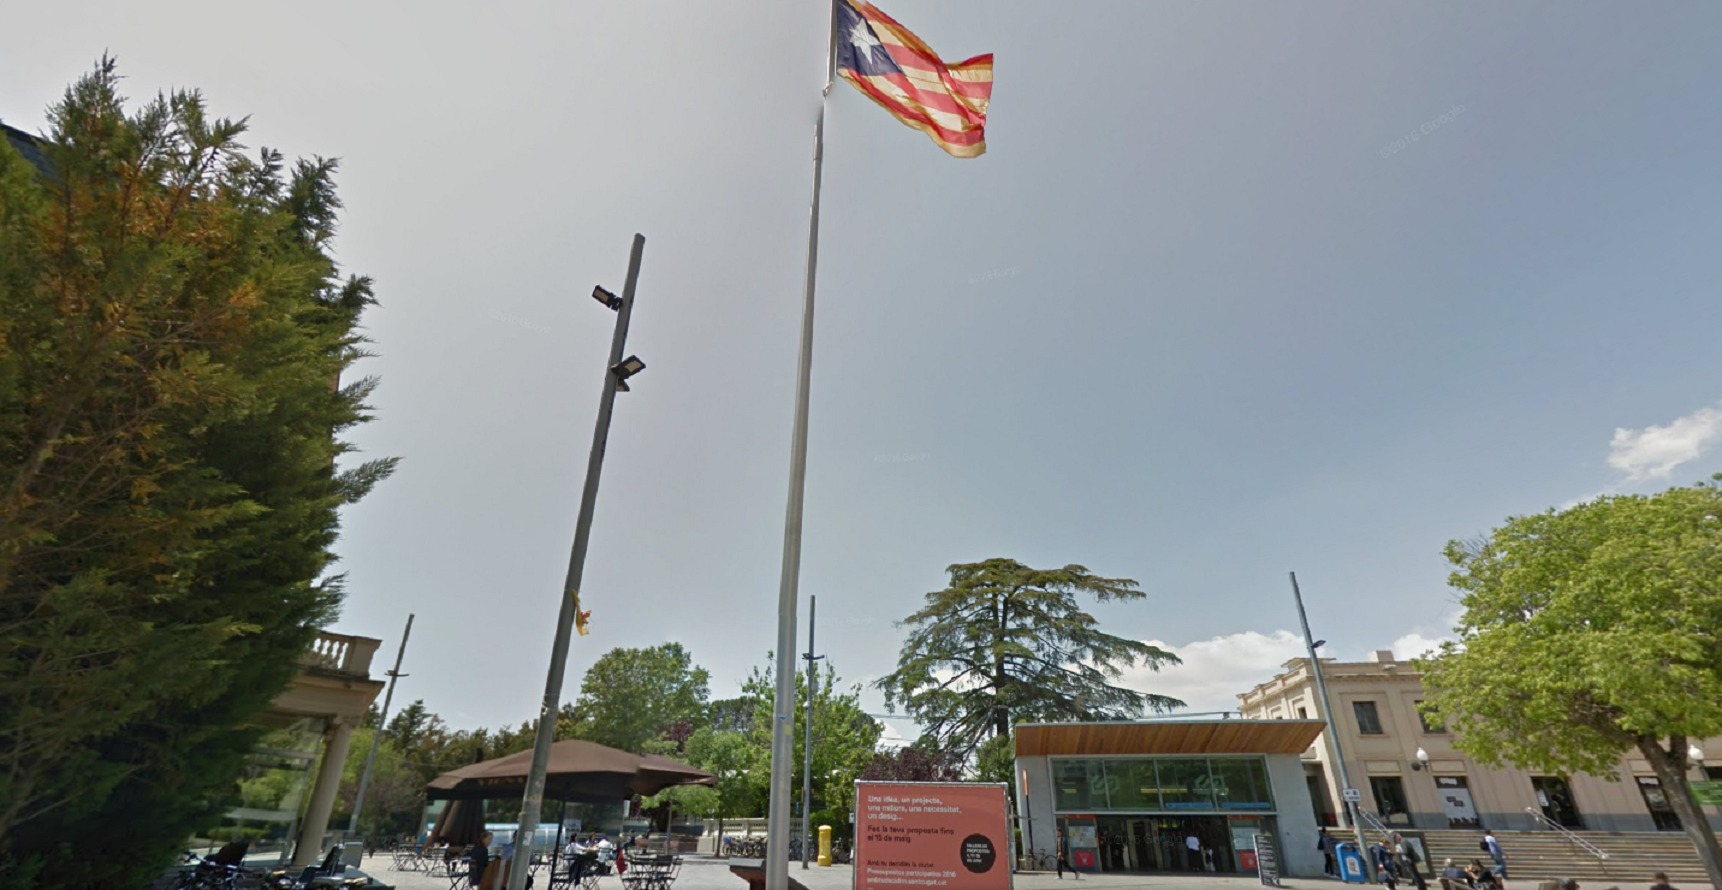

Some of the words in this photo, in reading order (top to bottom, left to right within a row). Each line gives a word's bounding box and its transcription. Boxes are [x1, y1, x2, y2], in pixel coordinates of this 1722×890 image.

[867, 795, 882, 803] Una
[883, 795, 900, 804] idea,
[911, 796, 943, 806] projecte,
[923, 806, 962, 814] necessitat,
[882, 825, 888, 833] la
[906, 826, 939, 835] proposta
[939, 827, 955, 835] fins
[894, 835, 911, 843] maig
